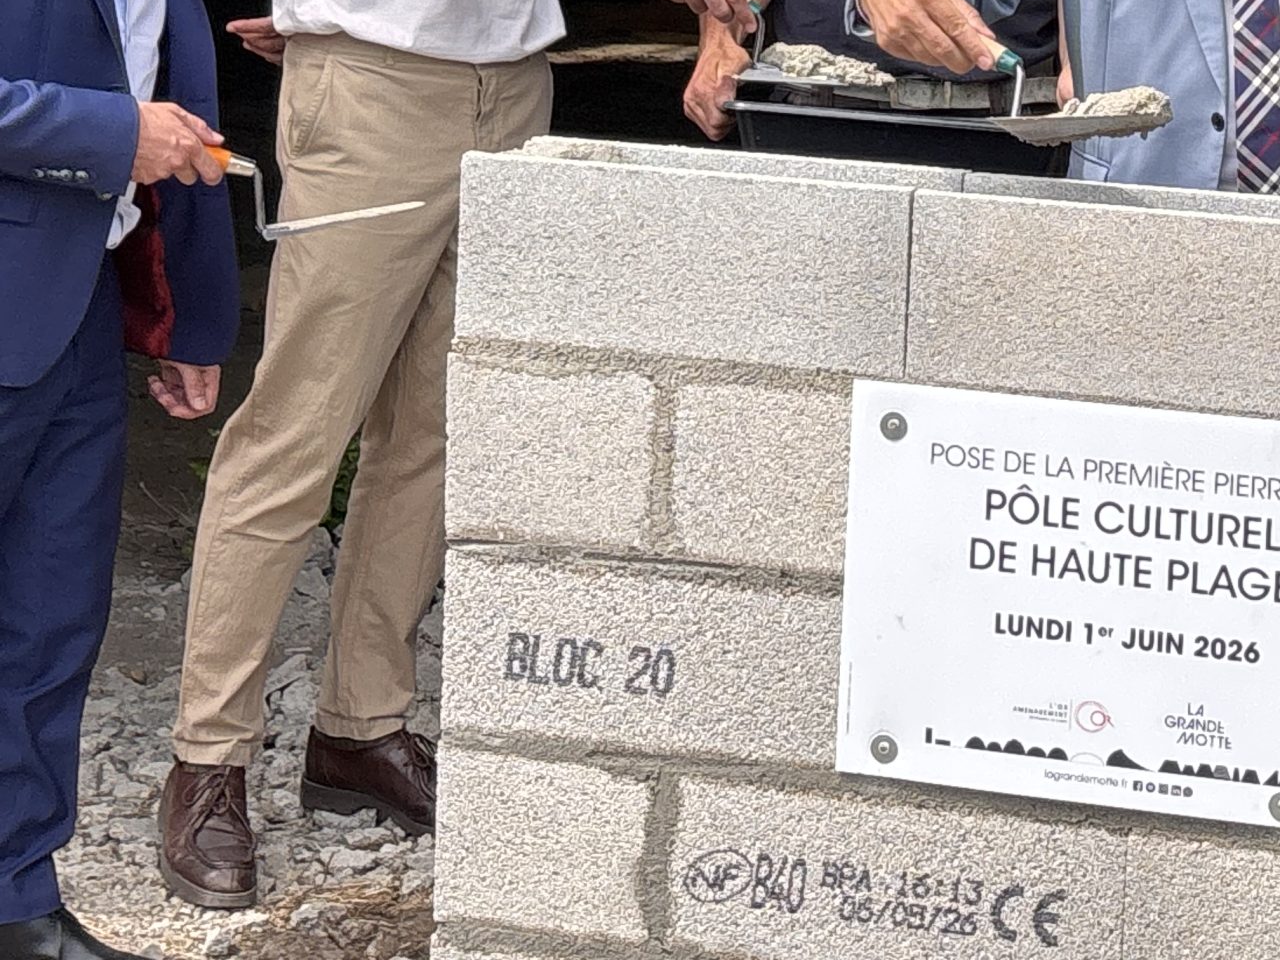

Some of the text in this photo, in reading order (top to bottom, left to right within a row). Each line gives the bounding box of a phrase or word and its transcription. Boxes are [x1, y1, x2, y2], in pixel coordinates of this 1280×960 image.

[930, 442, 995, 471] POSE
[1003, 450, 1036, 475] DE
[1045, 454, 1075, 479] LA
[1083, 458, 1205, 493] PREMIÈRE
[985, 483, 1080, 530] PÔLE
[969, 537, 1017, 573] DE
[1031, 543, 1152, 589] HAUTE
[995, 612, 1260, 663] LUNDI 1er JUIN 2026
[502, 632, 676, 697] BLOC 20
[1164, 715, 1225, 735] GRANDE
[1187, 702, 1204, 717] LA
[1176, 731, 1232, 749] MOTTE
[989, 884, 1068, 948] CE
